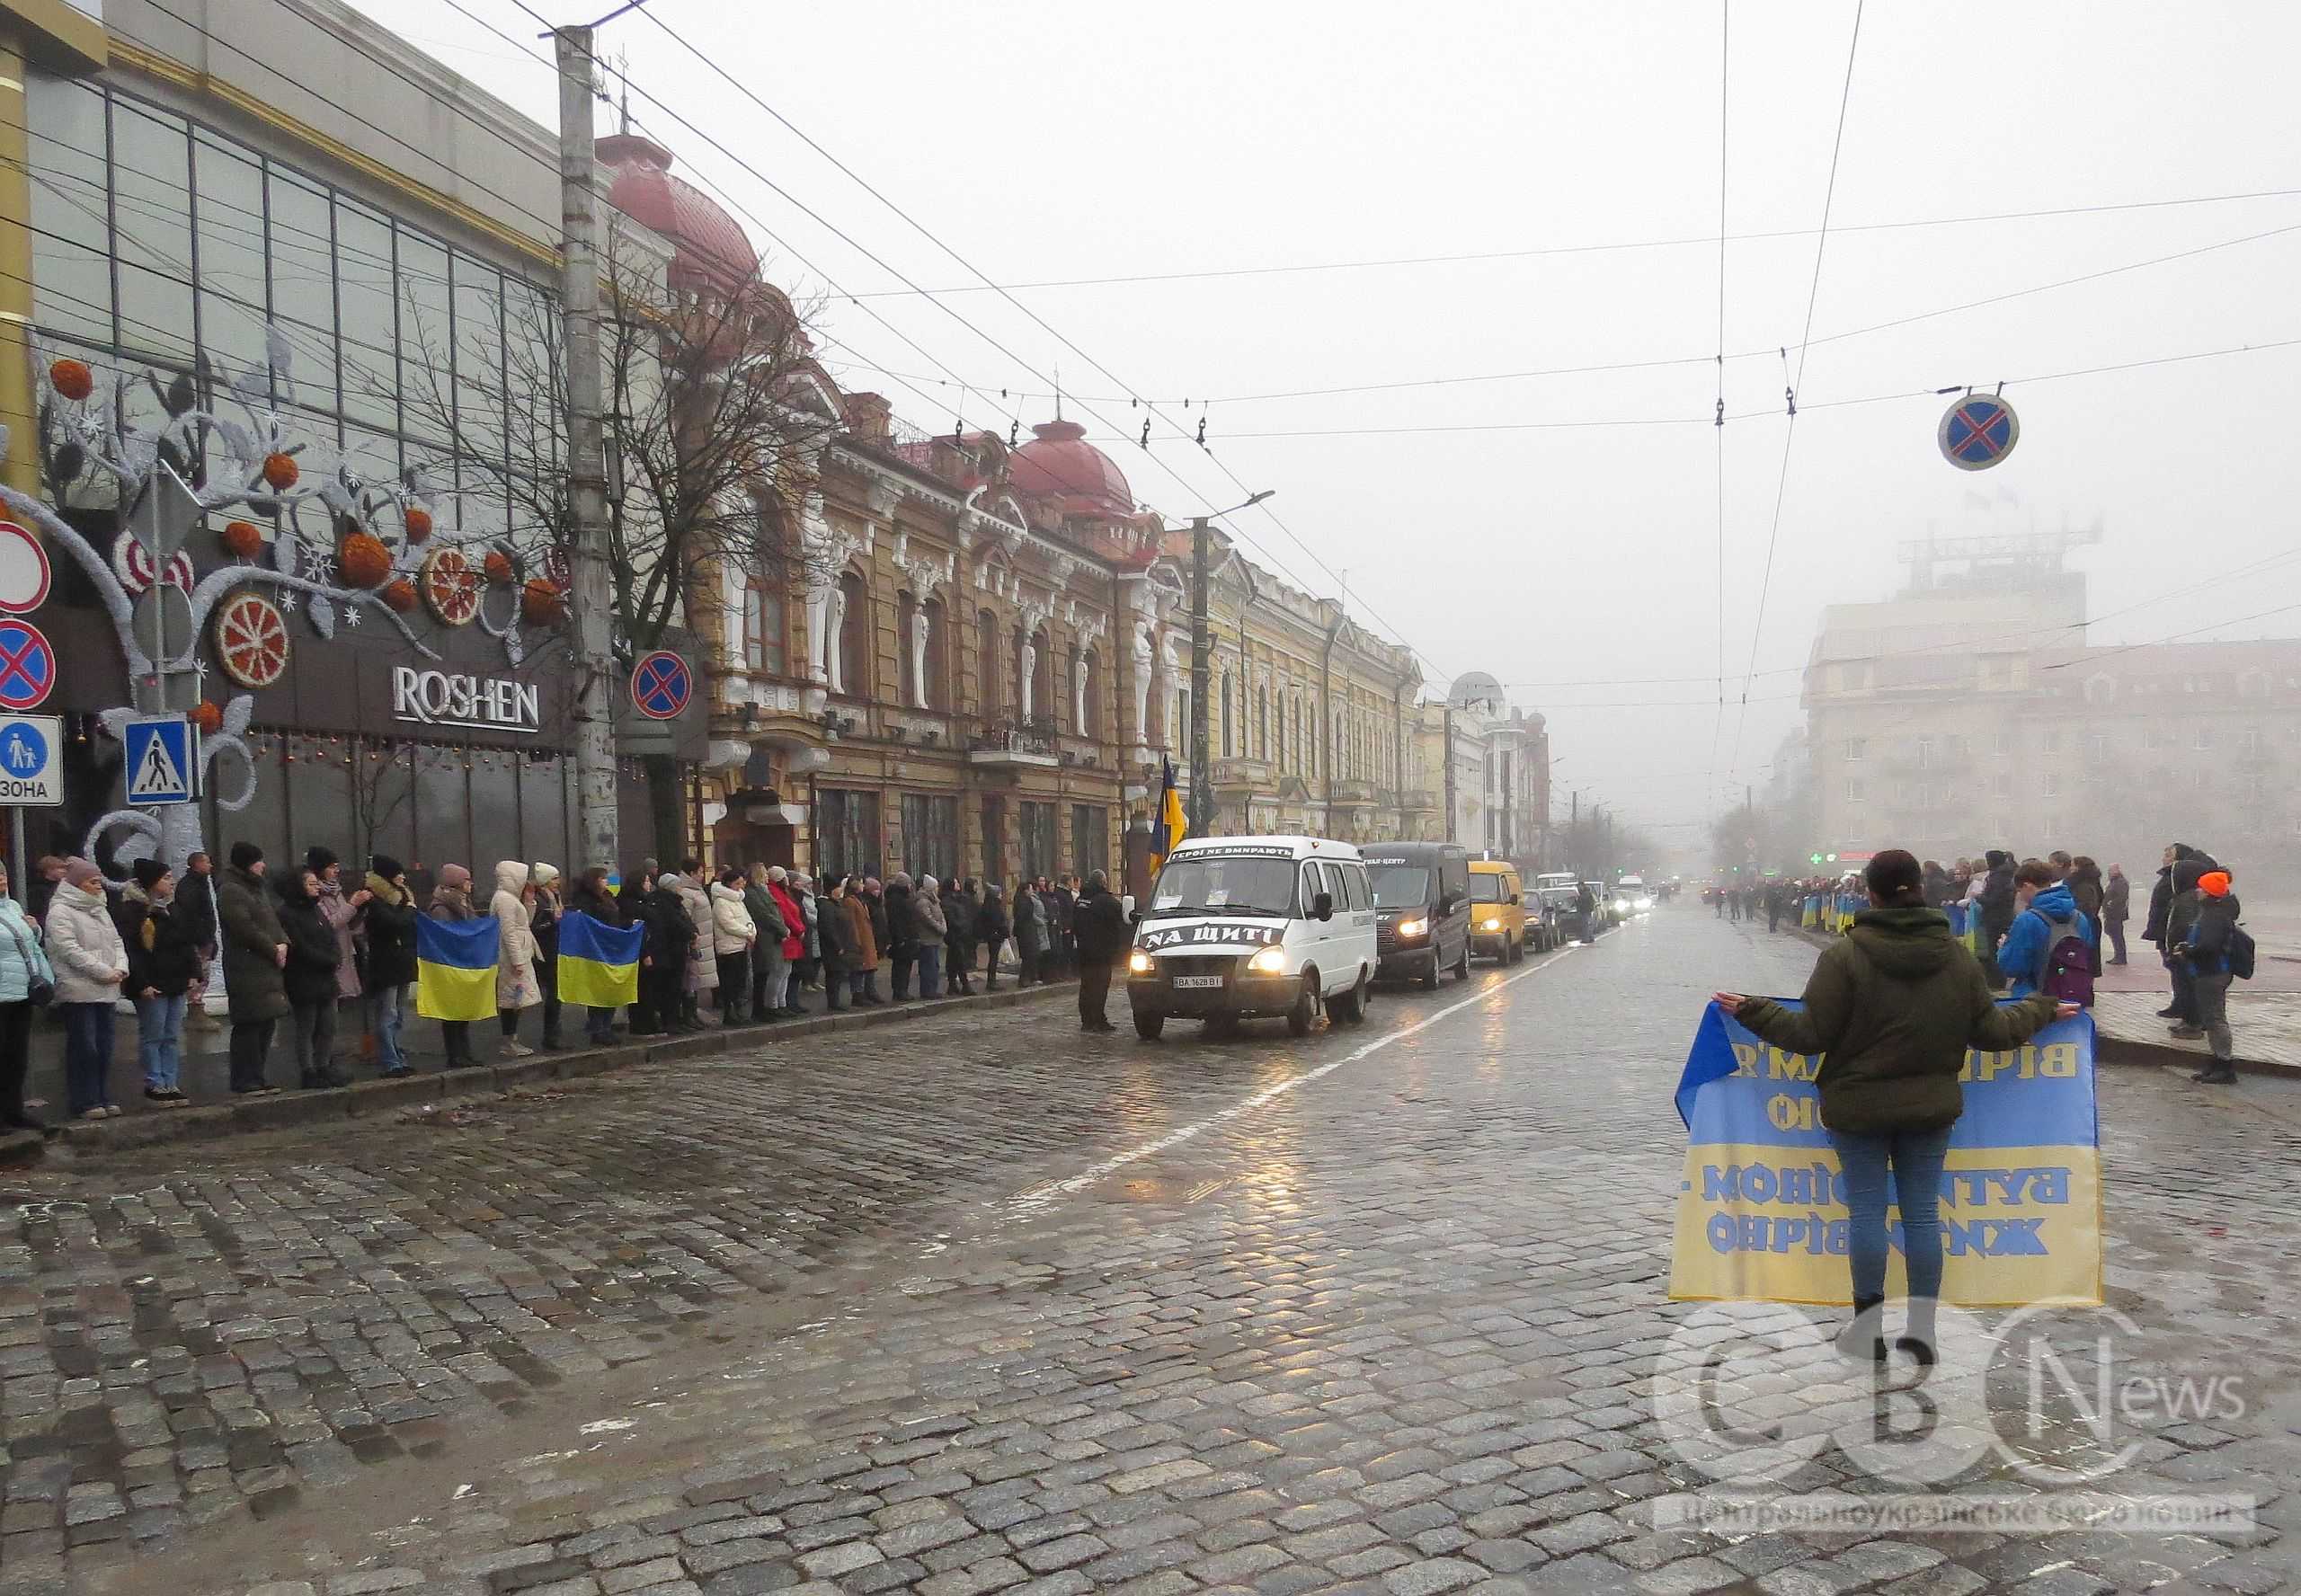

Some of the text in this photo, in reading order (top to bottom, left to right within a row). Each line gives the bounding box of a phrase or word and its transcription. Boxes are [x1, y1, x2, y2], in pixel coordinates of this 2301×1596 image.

[393, 666, 539, 726] ROSHEN
[0, 780, 49, 798] ЗОНА
[1193, 926, 1273, 944] ЩИТІ
